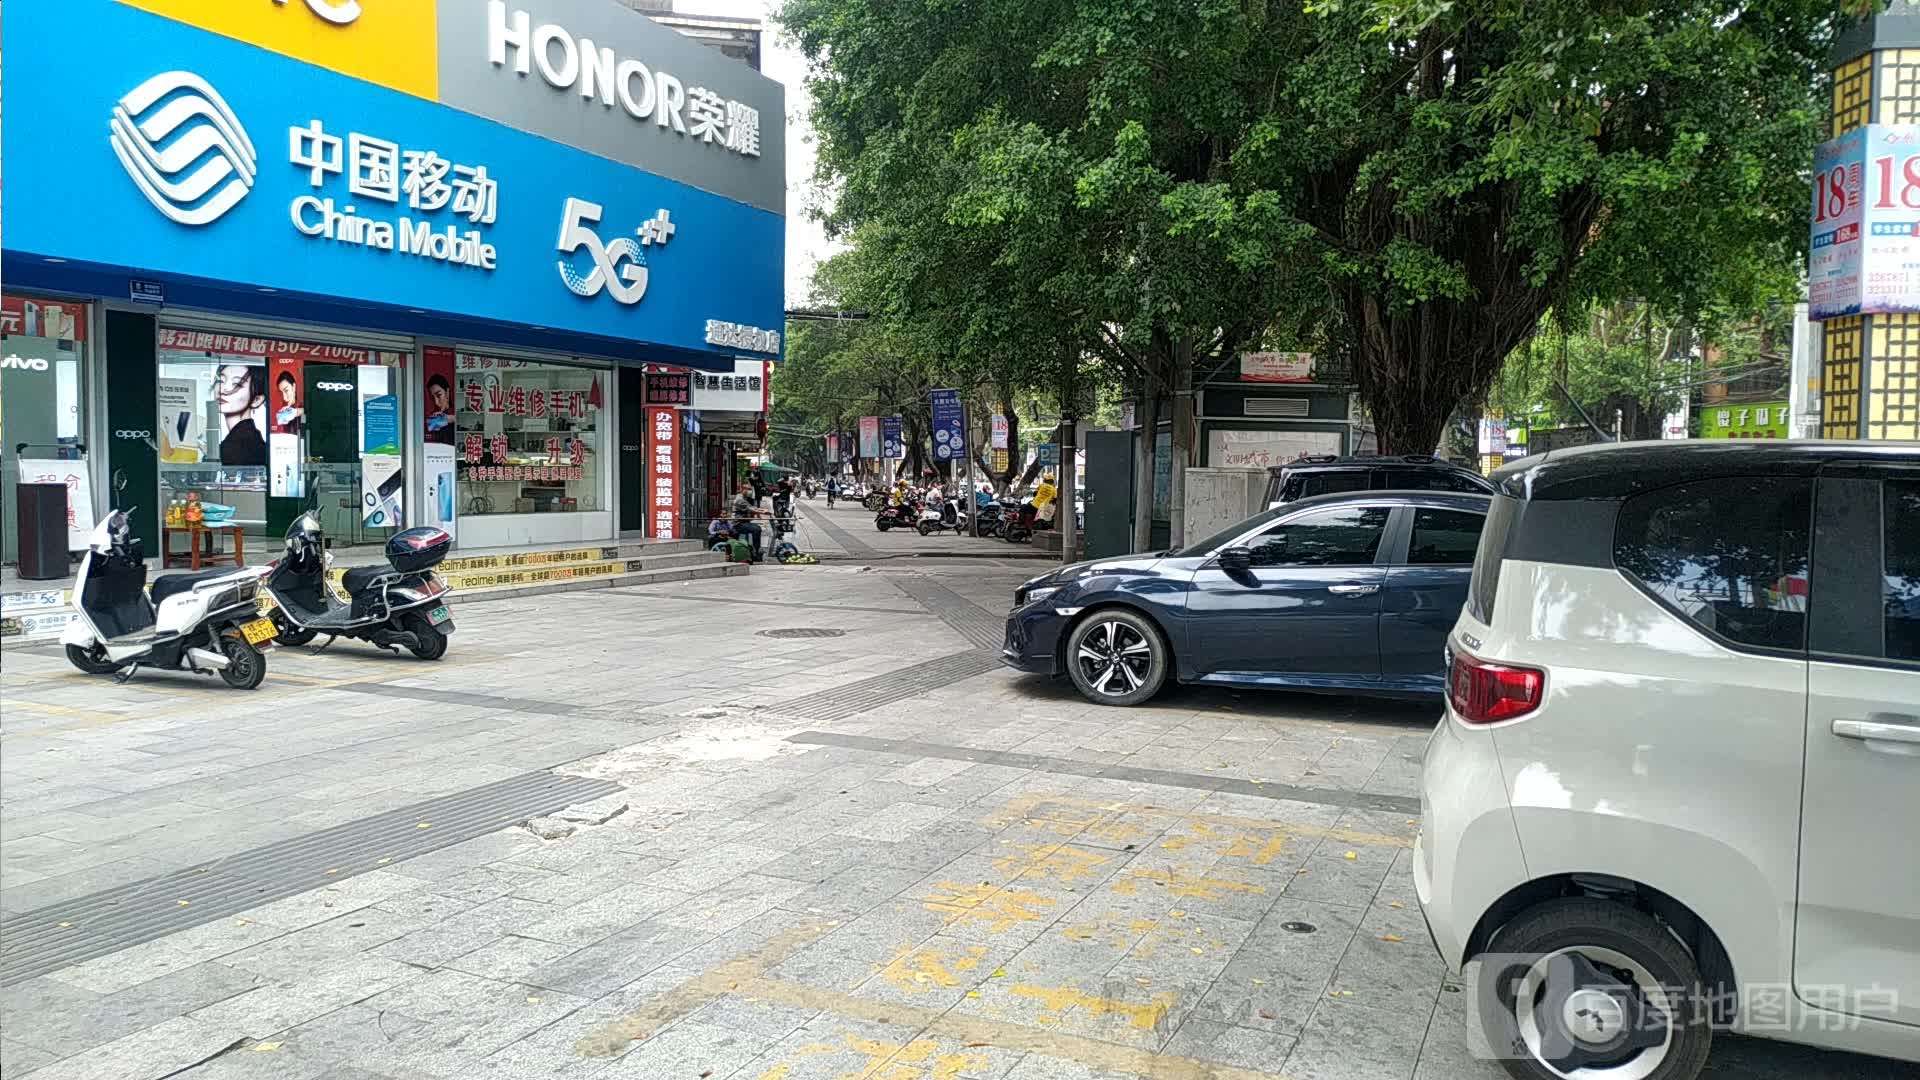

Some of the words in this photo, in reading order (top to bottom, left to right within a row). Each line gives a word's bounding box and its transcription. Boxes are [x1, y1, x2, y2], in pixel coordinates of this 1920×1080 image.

[488, 0, 684, 133] HONOR
[686, 86, 761, 156] 荣耀
[289, 119, 498, 224] 中国移动
[1815, 166, 1846, 223] 18
[290, 195, 394, 250] China
[399, 217, 497, 269] Mobile
[1, 354, 49, 371] vivo
[316, 381, 353, 392] oppo
[695, 374, 761, 391] 智慧生活馆
[465, 382, 584, 419] 专业维修手机
[115, 430, 151, 440] oppo
[655, 411, 673, 441] 办宽带
[464, 433, 509, 465] 解锁
[546, 437, 585, 465] 升级
[655, 445, 673, 474] 看电视
[655, 478, 673, 506] 装监控
[655, 511, 673, 539] 选联通
[461, 575, 494, 587] realme
